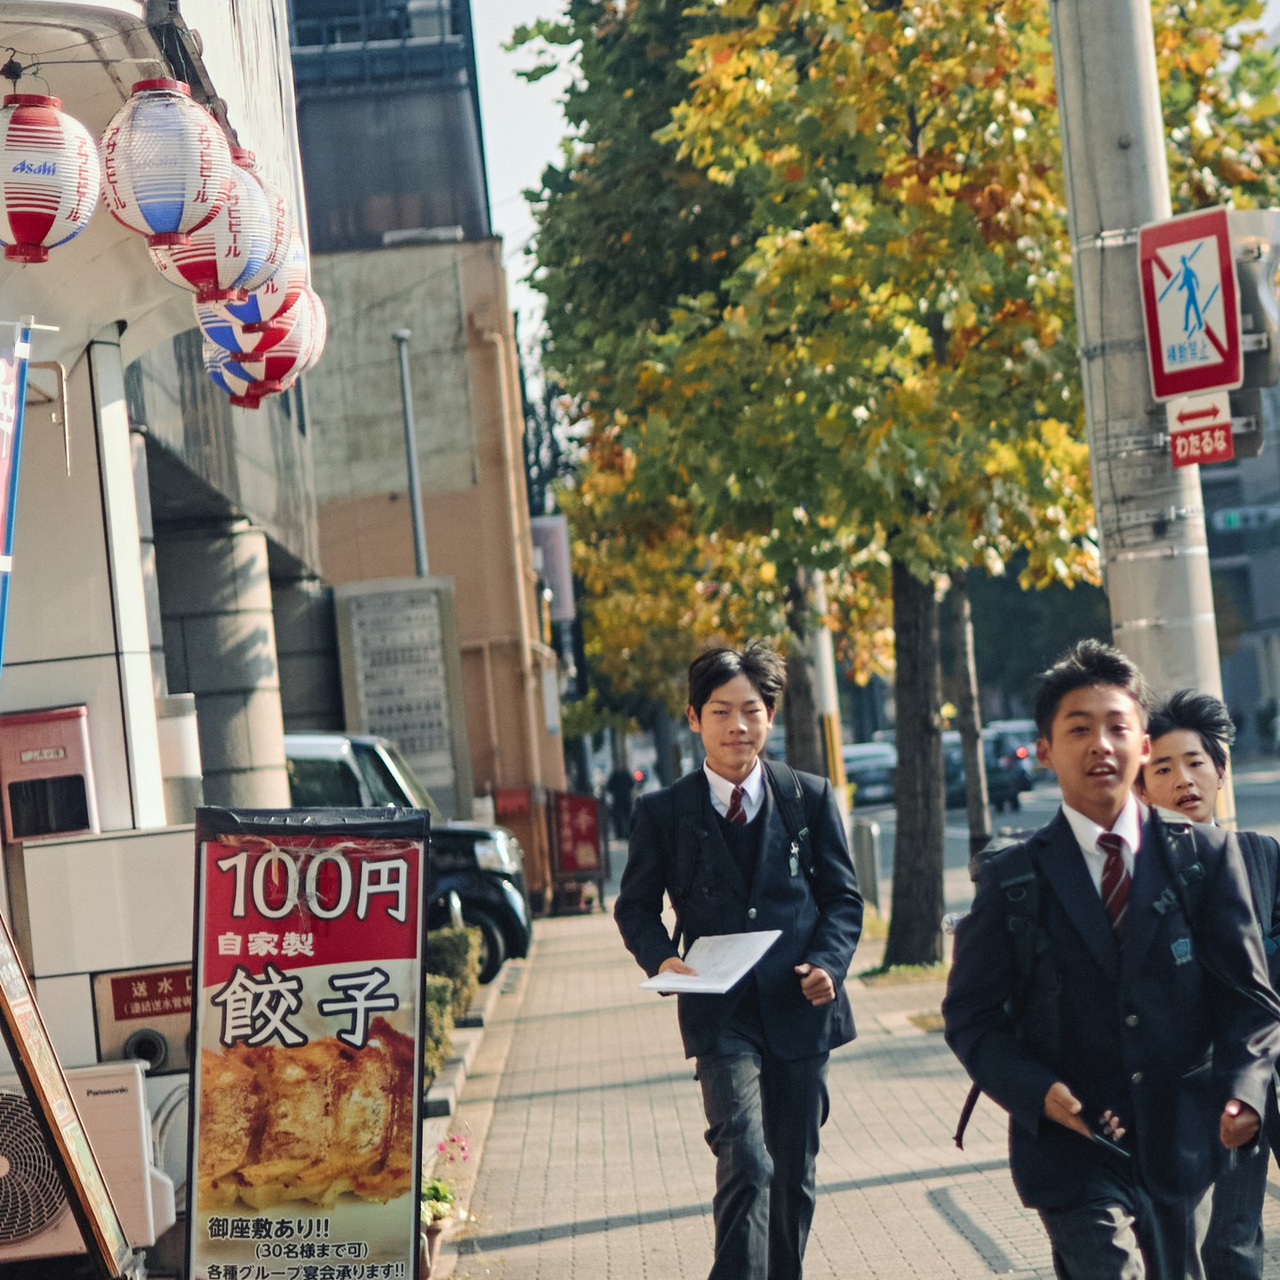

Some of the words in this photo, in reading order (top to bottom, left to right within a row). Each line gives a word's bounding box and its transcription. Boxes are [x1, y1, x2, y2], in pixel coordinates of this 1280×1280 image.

[12, 159, 58, 176] Asahi
[65, 135, 89, 222] アサヒビール
[104, 126, 127, 210] アサヒビール
[1175, 428, 1227, 458] わたるな
[216, 850, 408, 923] 100円
[217, 931, 315, 957] 自家製
[212, 964, 397, 1048] 餃子
[86, 1085, 129, 1097] Panasonic
[208, 1216, 331, 1240] 御座敷あり!!
[255, 1242, 369, 1260] (30名様まで可)
